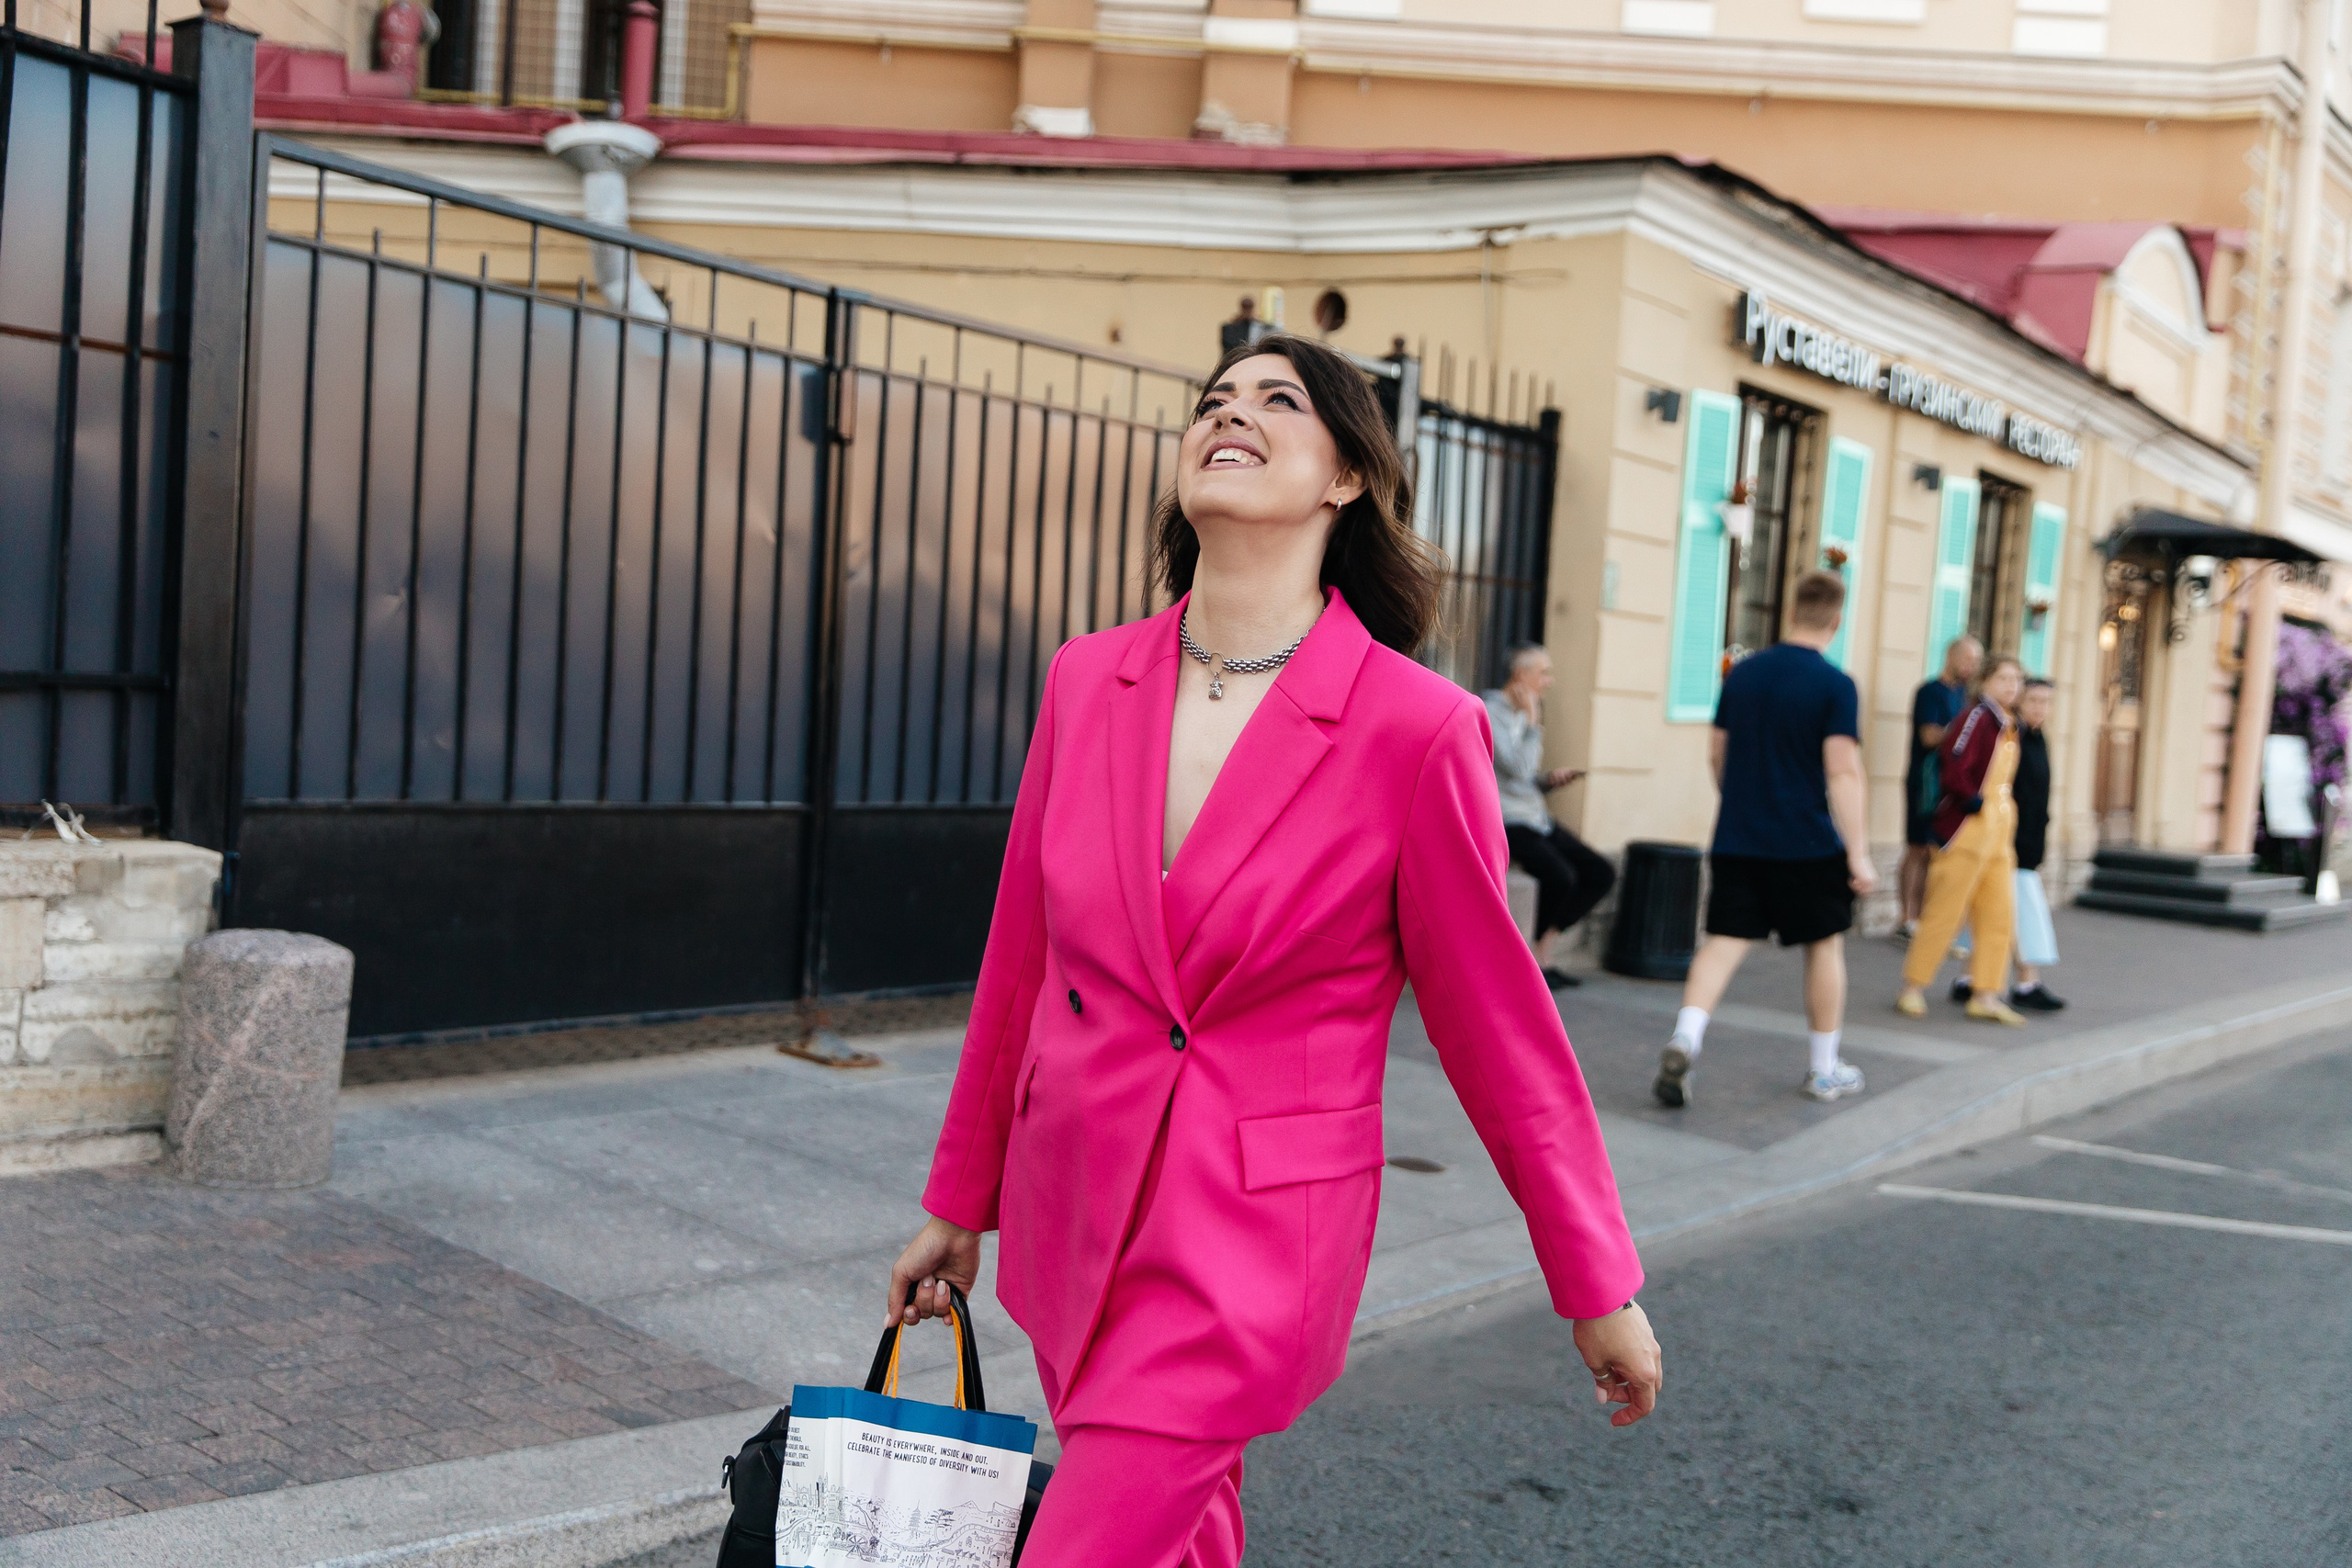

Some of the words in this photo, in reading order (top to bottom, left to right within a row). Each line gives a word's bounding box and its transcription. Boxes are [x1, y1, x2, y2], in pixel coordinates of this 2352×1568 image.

[1746, 288, 1880, 393] Руставели
[847, 1441, 880, 1456] CELEBRATE
[882, 1449, 892, 1460] THE
[893, 1452, 928, 1465] MANIFESTO
[929, 1457, 938, 1466] OF
[939, 1459, 968, 1472] DIVERSITY
[970, 1466, 986, 1476] WITH
[988, 1470, 1000, 1479] US!
[861, 1433, 885, 1445] BEAUTY
[886, 1438, 892, 1447] IS
[893, 1439, 937, 1455] EVERYWHERE,
[940, 1448, 960, 1459] INSIDE
[961, 1451, 973, 1462] AND
[975, 1455, 989, 1465] OUT.
